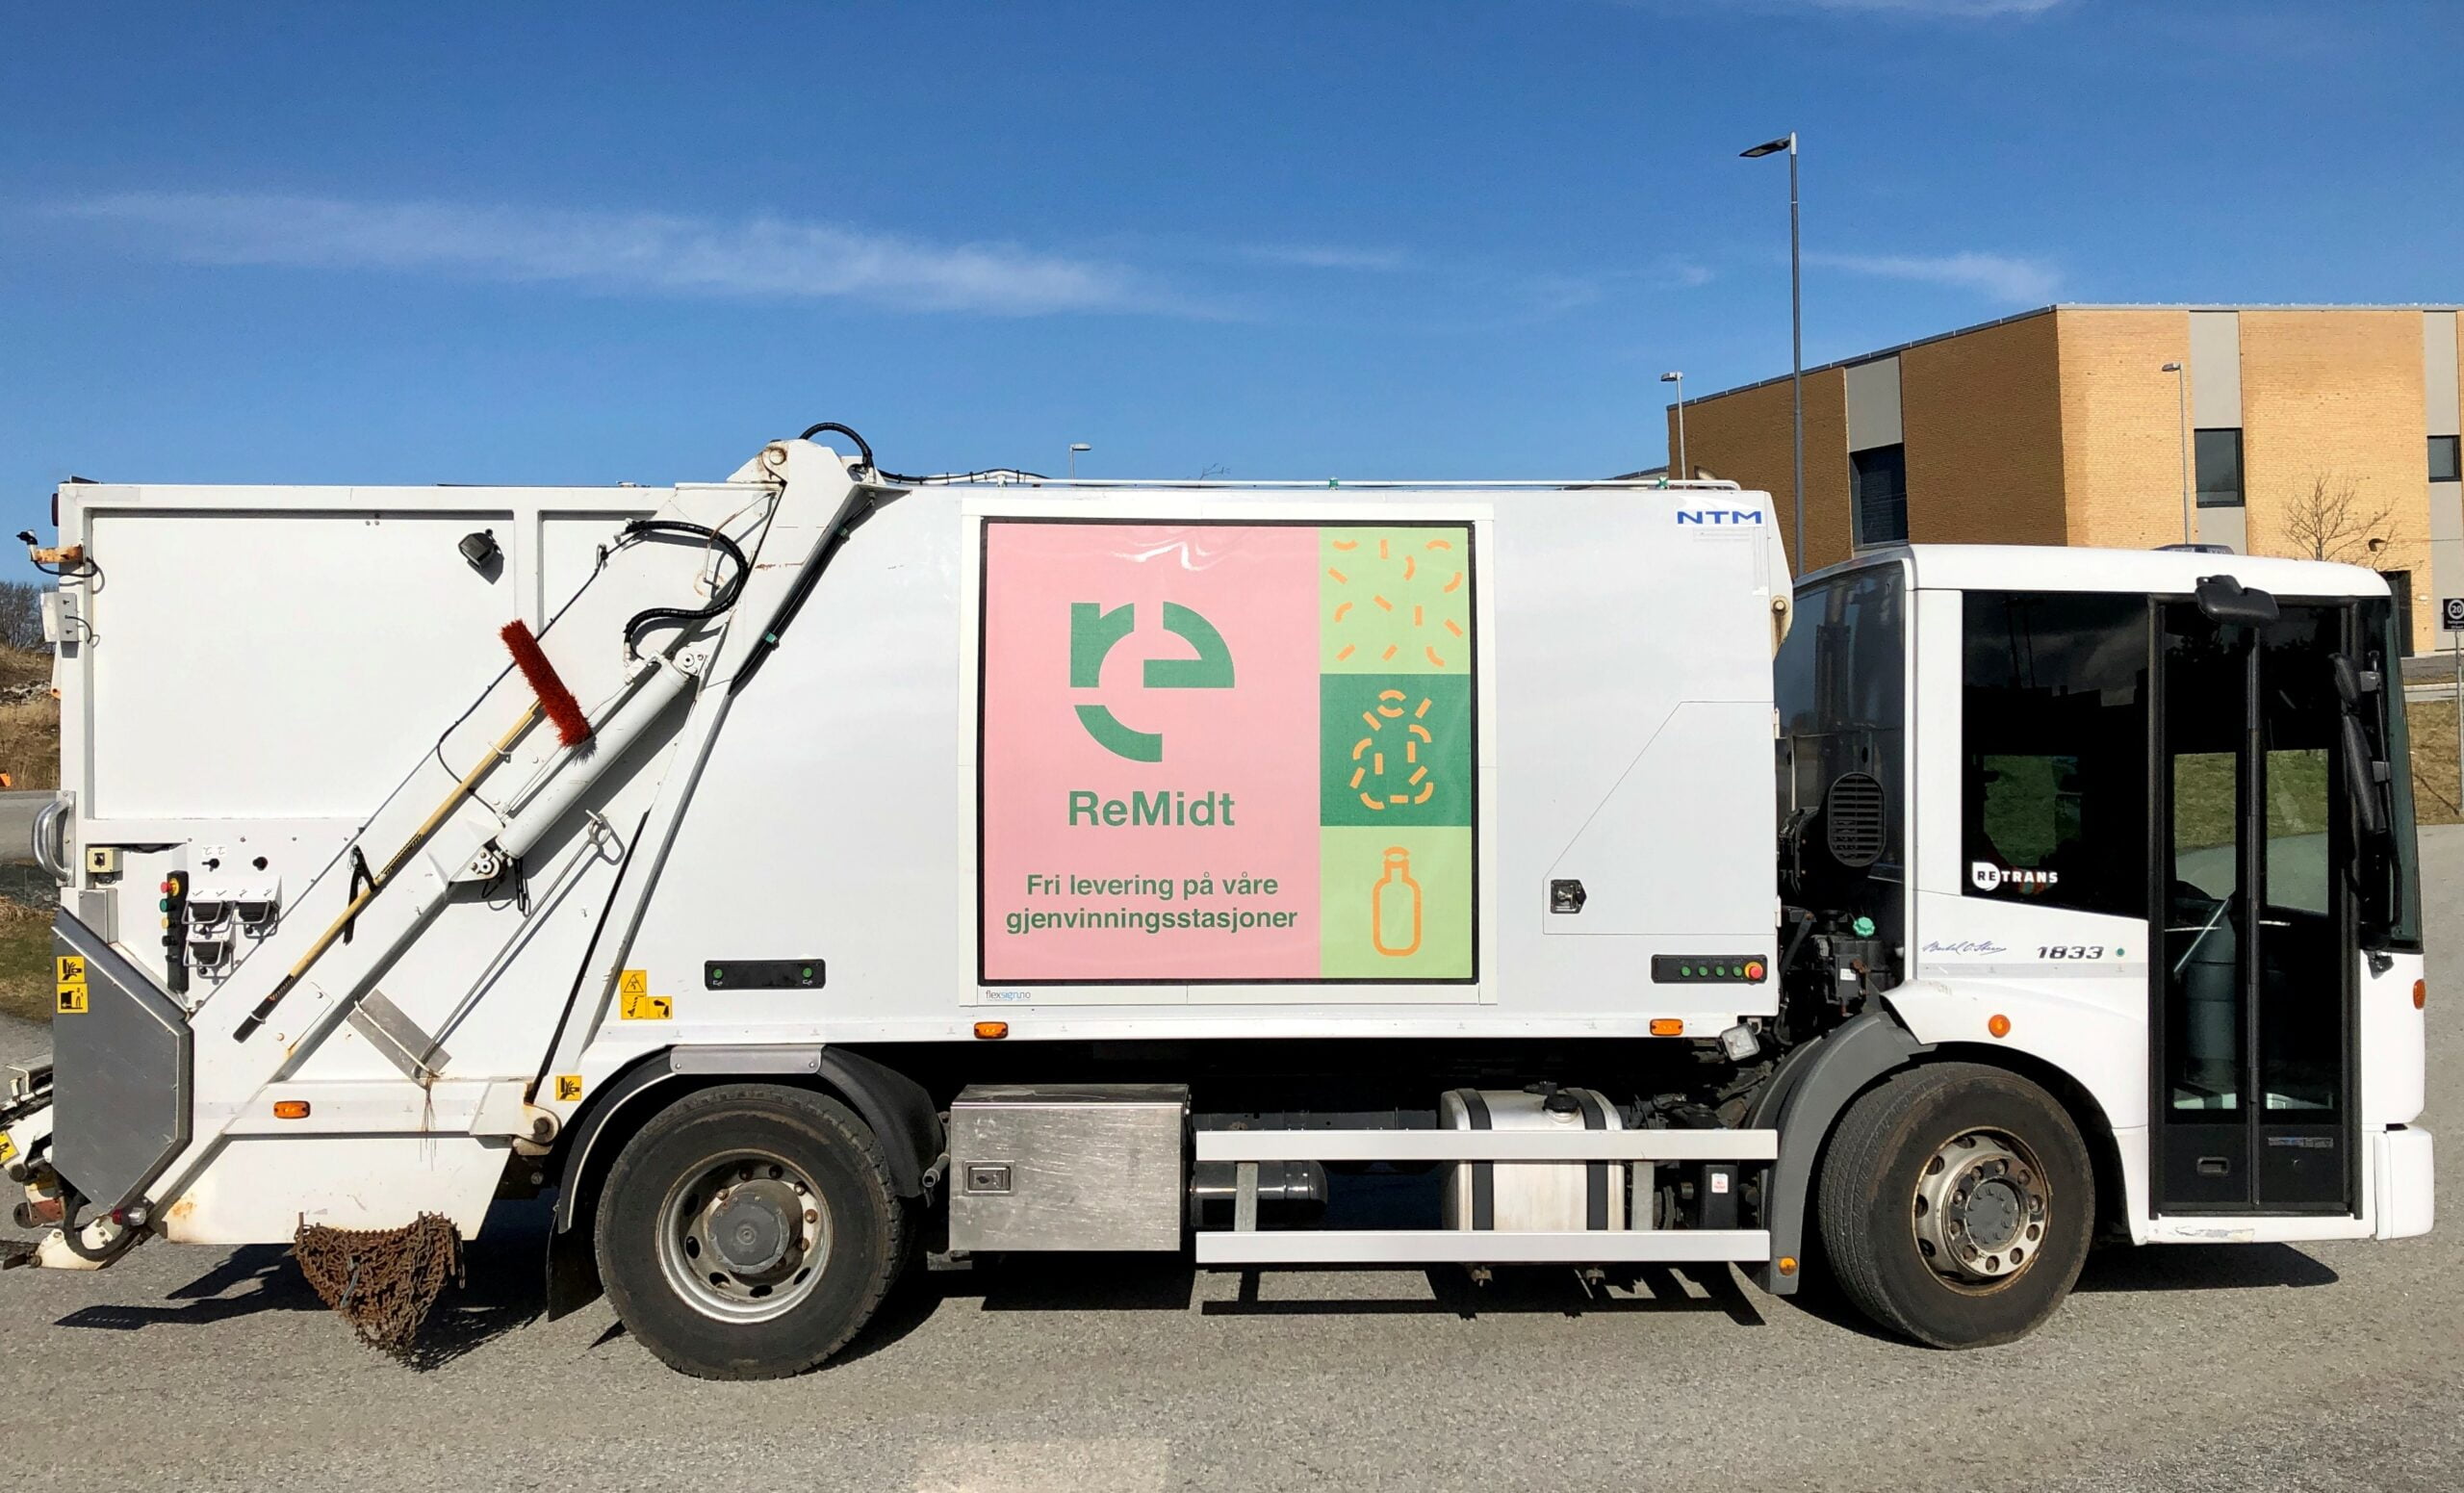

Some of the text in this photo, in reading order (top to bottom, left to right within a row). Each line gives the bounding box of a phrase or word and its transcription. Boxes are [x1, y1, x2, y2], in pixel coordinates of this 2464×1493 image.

[1677, 510, 1761, 525] NTM
[2451, 605, 2462, 614] 20
[1068, 790, 1235, 827] ReMidt
[1976, 869, 2058, 883] RETRANS
[1027, 871, 1278, 901] Fri levering på våre
[1006, 907, 1297, 935] gjenvinningsstasjoner
[2036, 945, 2105, 960] 1833
